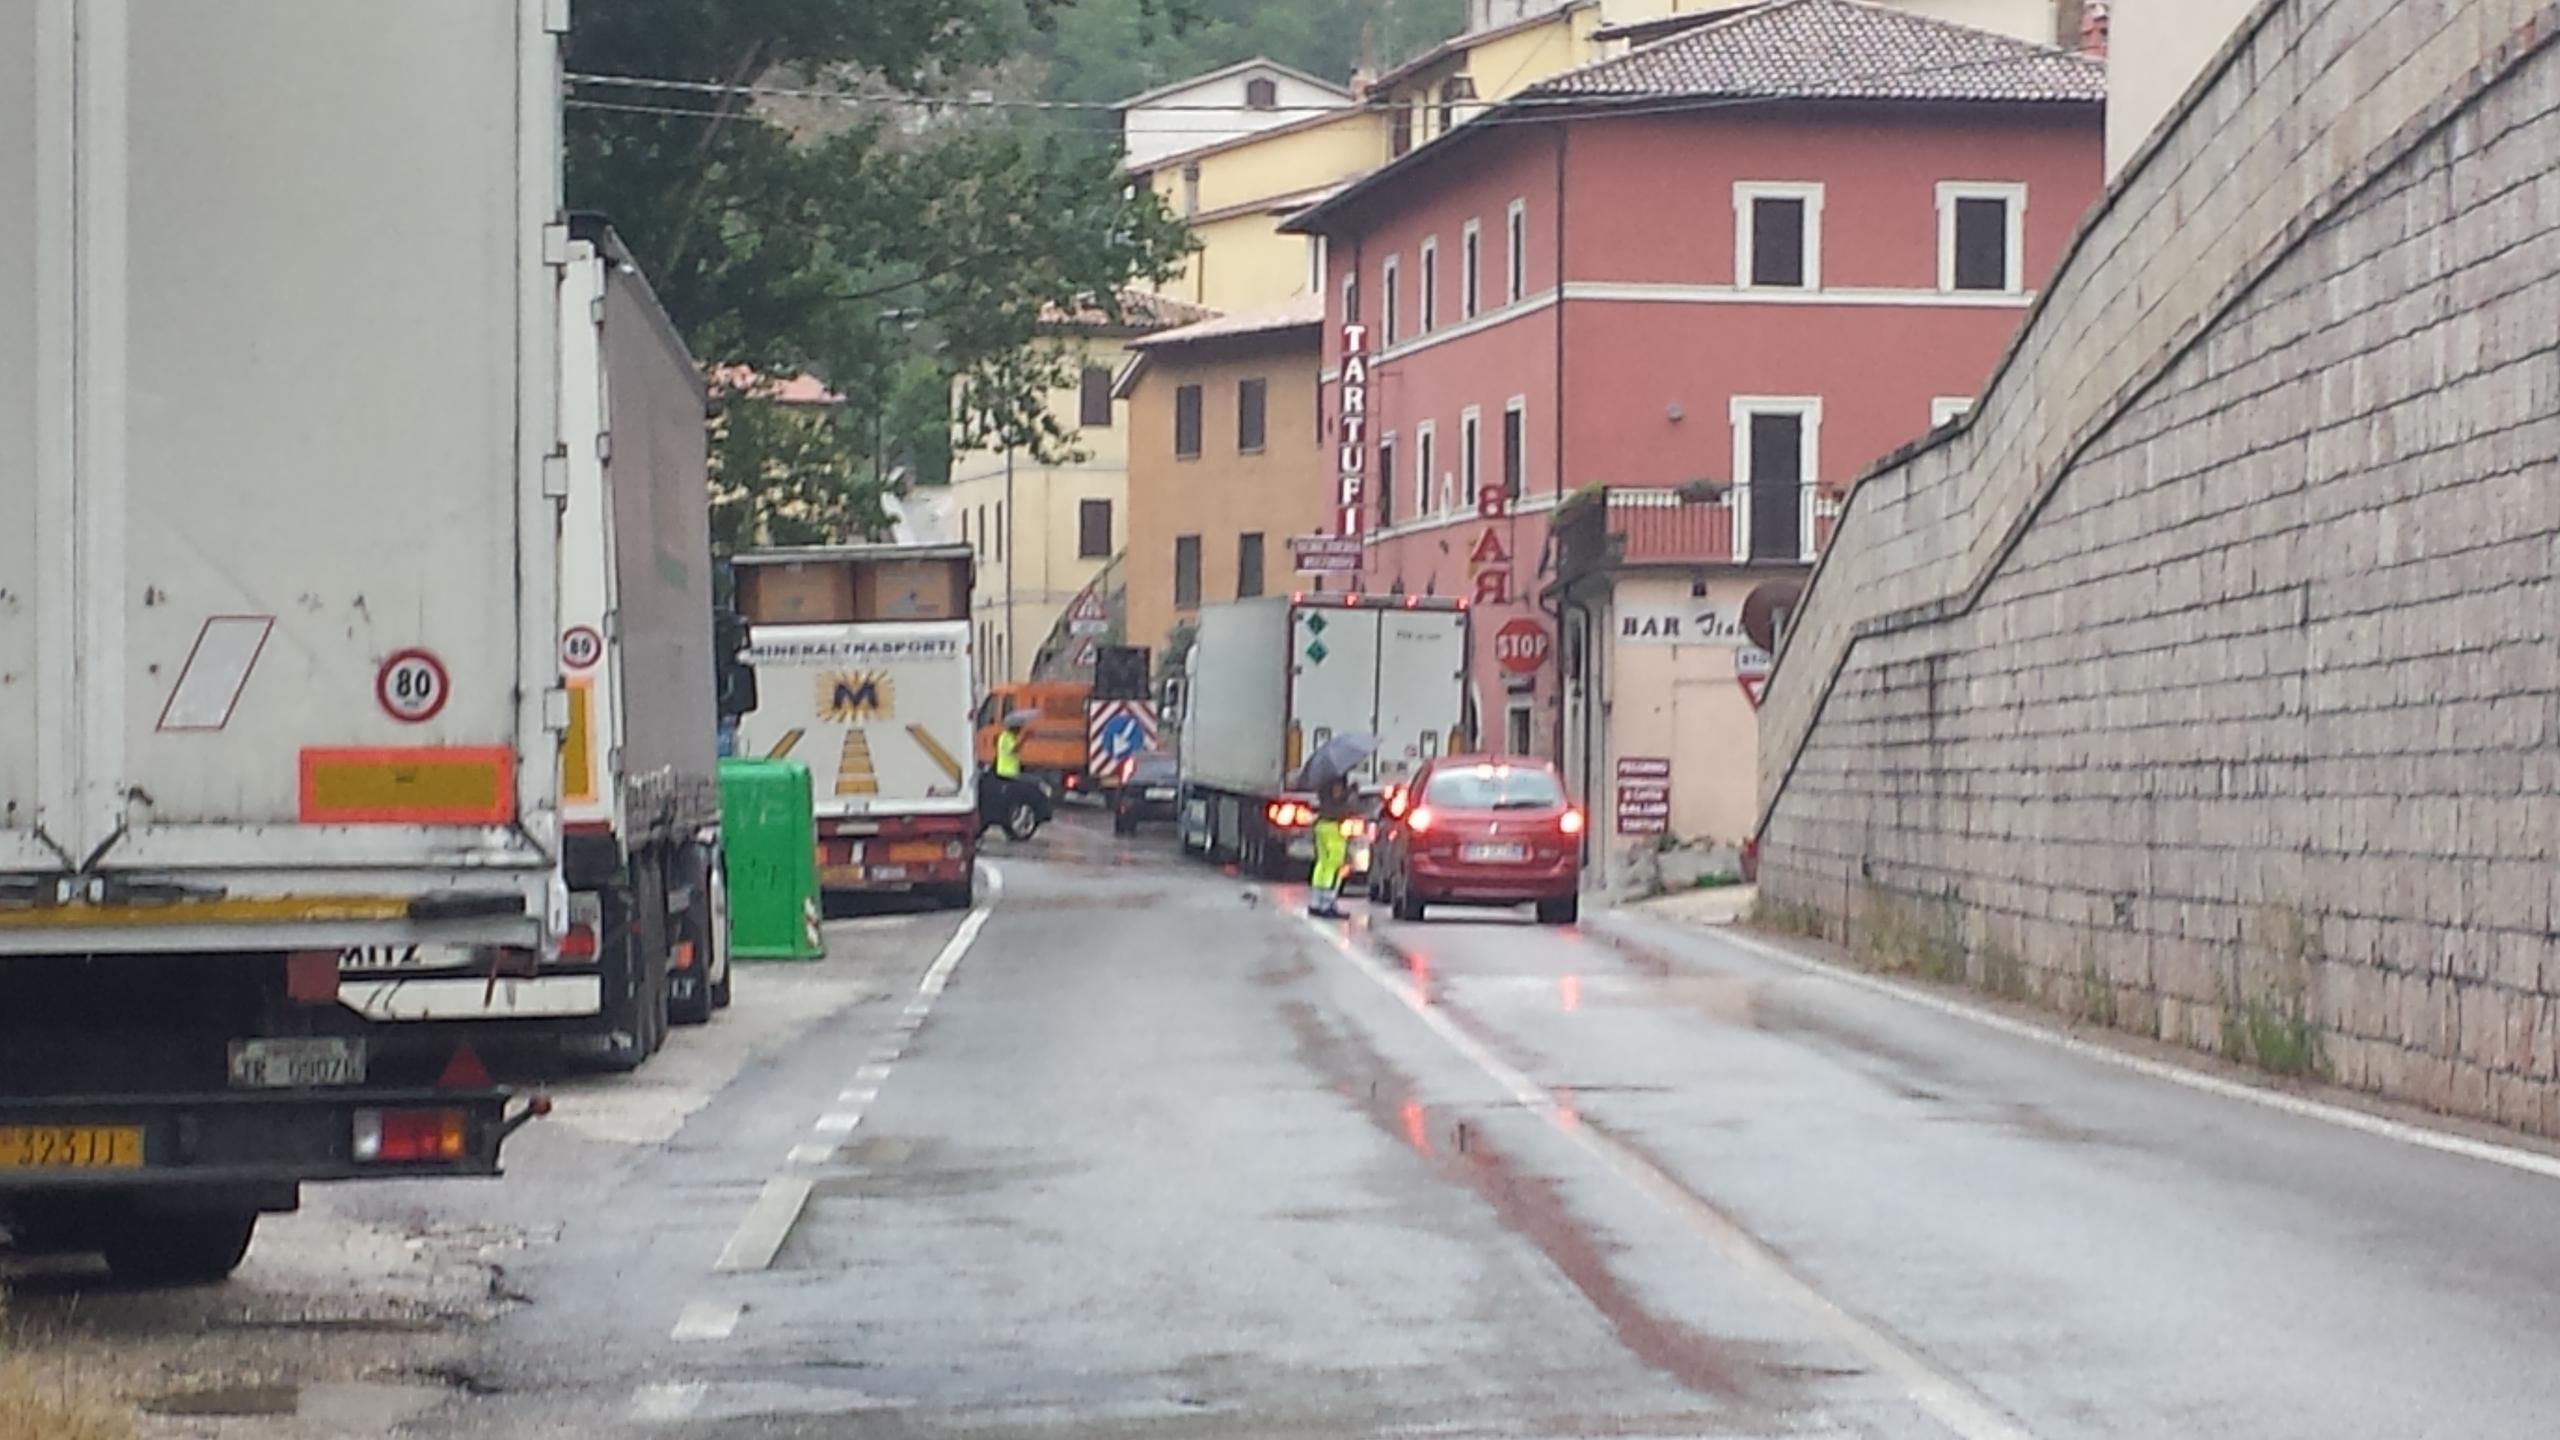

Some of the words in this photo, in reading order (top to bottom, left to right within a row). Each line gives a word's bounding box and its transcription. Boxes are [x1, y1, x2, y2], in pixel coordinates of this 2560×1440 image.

[1342, 325, 1366, 535] TARTUFI
[1622, 616, 1680, 636] BAR
[569, 639, 591, 654] 80
[1497, 633, 1546, 658] STOP
[396, 667, 431, 698] 80
[832, 682, 879, 709] M
